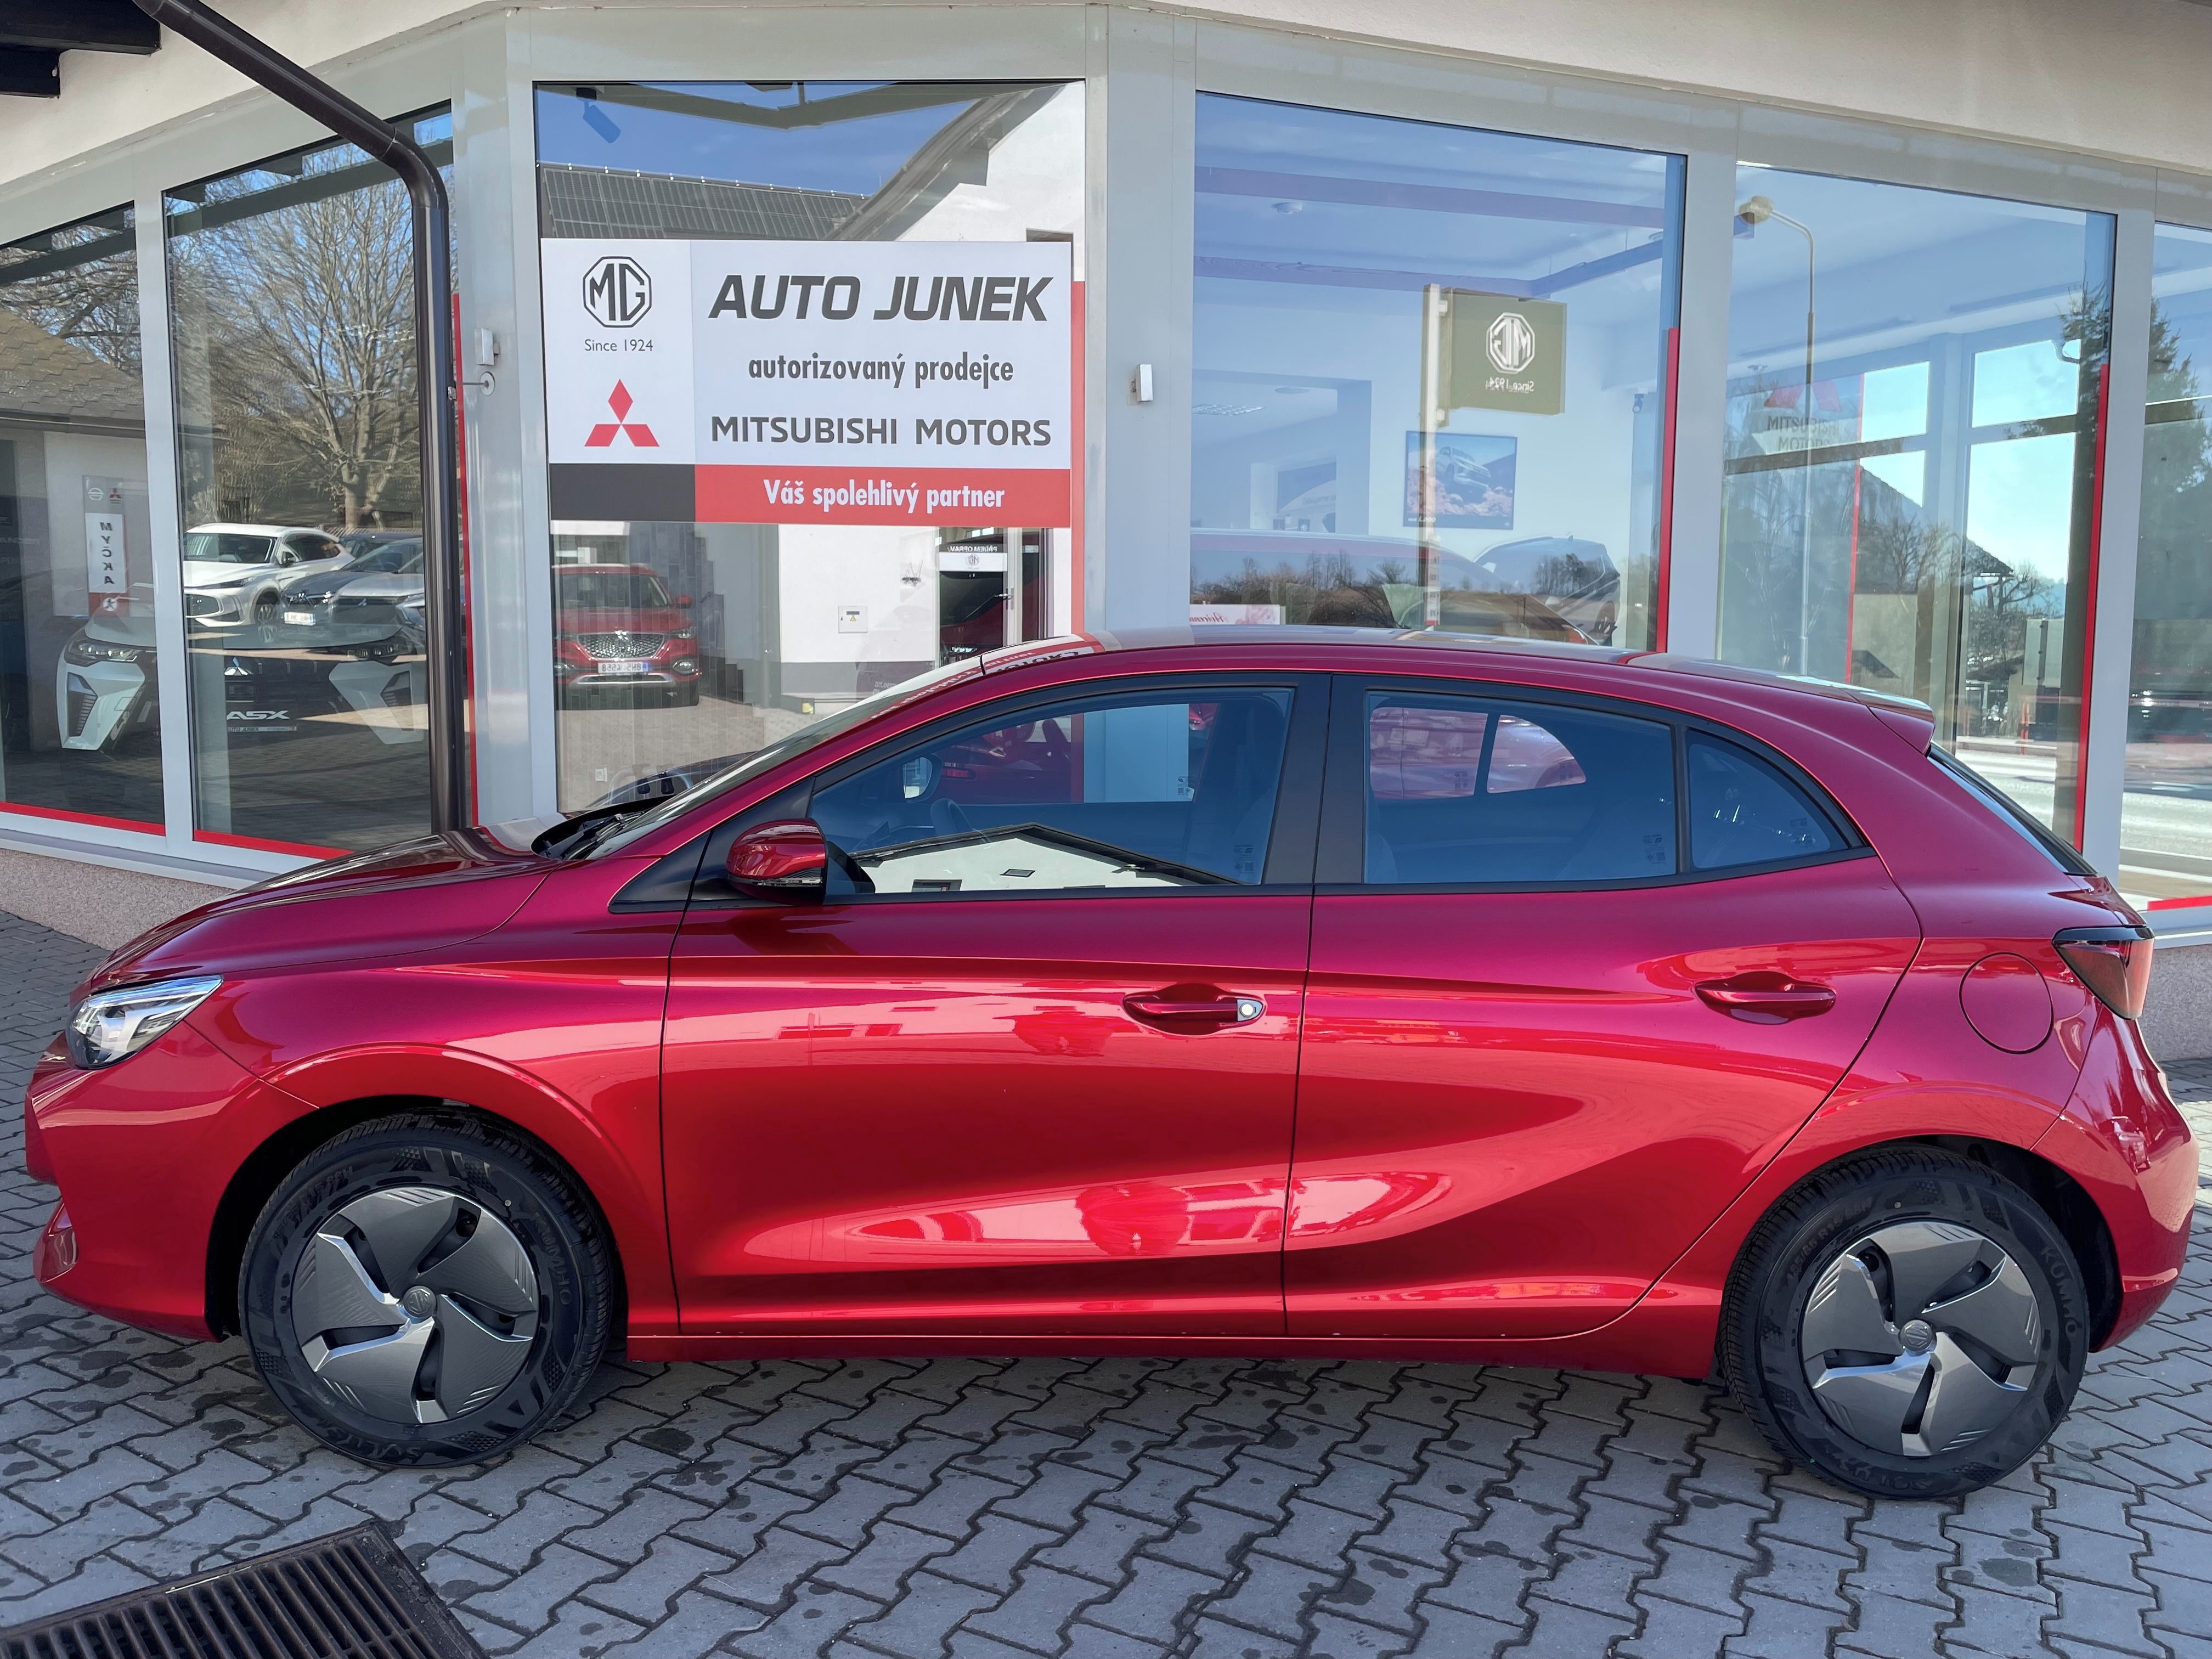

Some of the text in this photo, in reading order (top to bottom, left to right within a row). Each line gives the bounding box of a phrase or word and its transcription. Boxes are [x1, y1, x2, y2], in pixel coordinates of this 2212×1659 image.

[589, 263, 646, 321] MG
[708, 275, 1053, 321] AUTO JUNEK
[585, 338, 653, 352] Since 1924
[749, 352, 1013, 389] autorizovaný prodejce
[712, 416, 1051, 446] MITSUBISHI MOTORS
[1767, 415, 1839, 436] MITSUBISHI
[763, 479, 1005, 514] Váš spolehlivý partner
[226, 710, 290, 720] ASX
